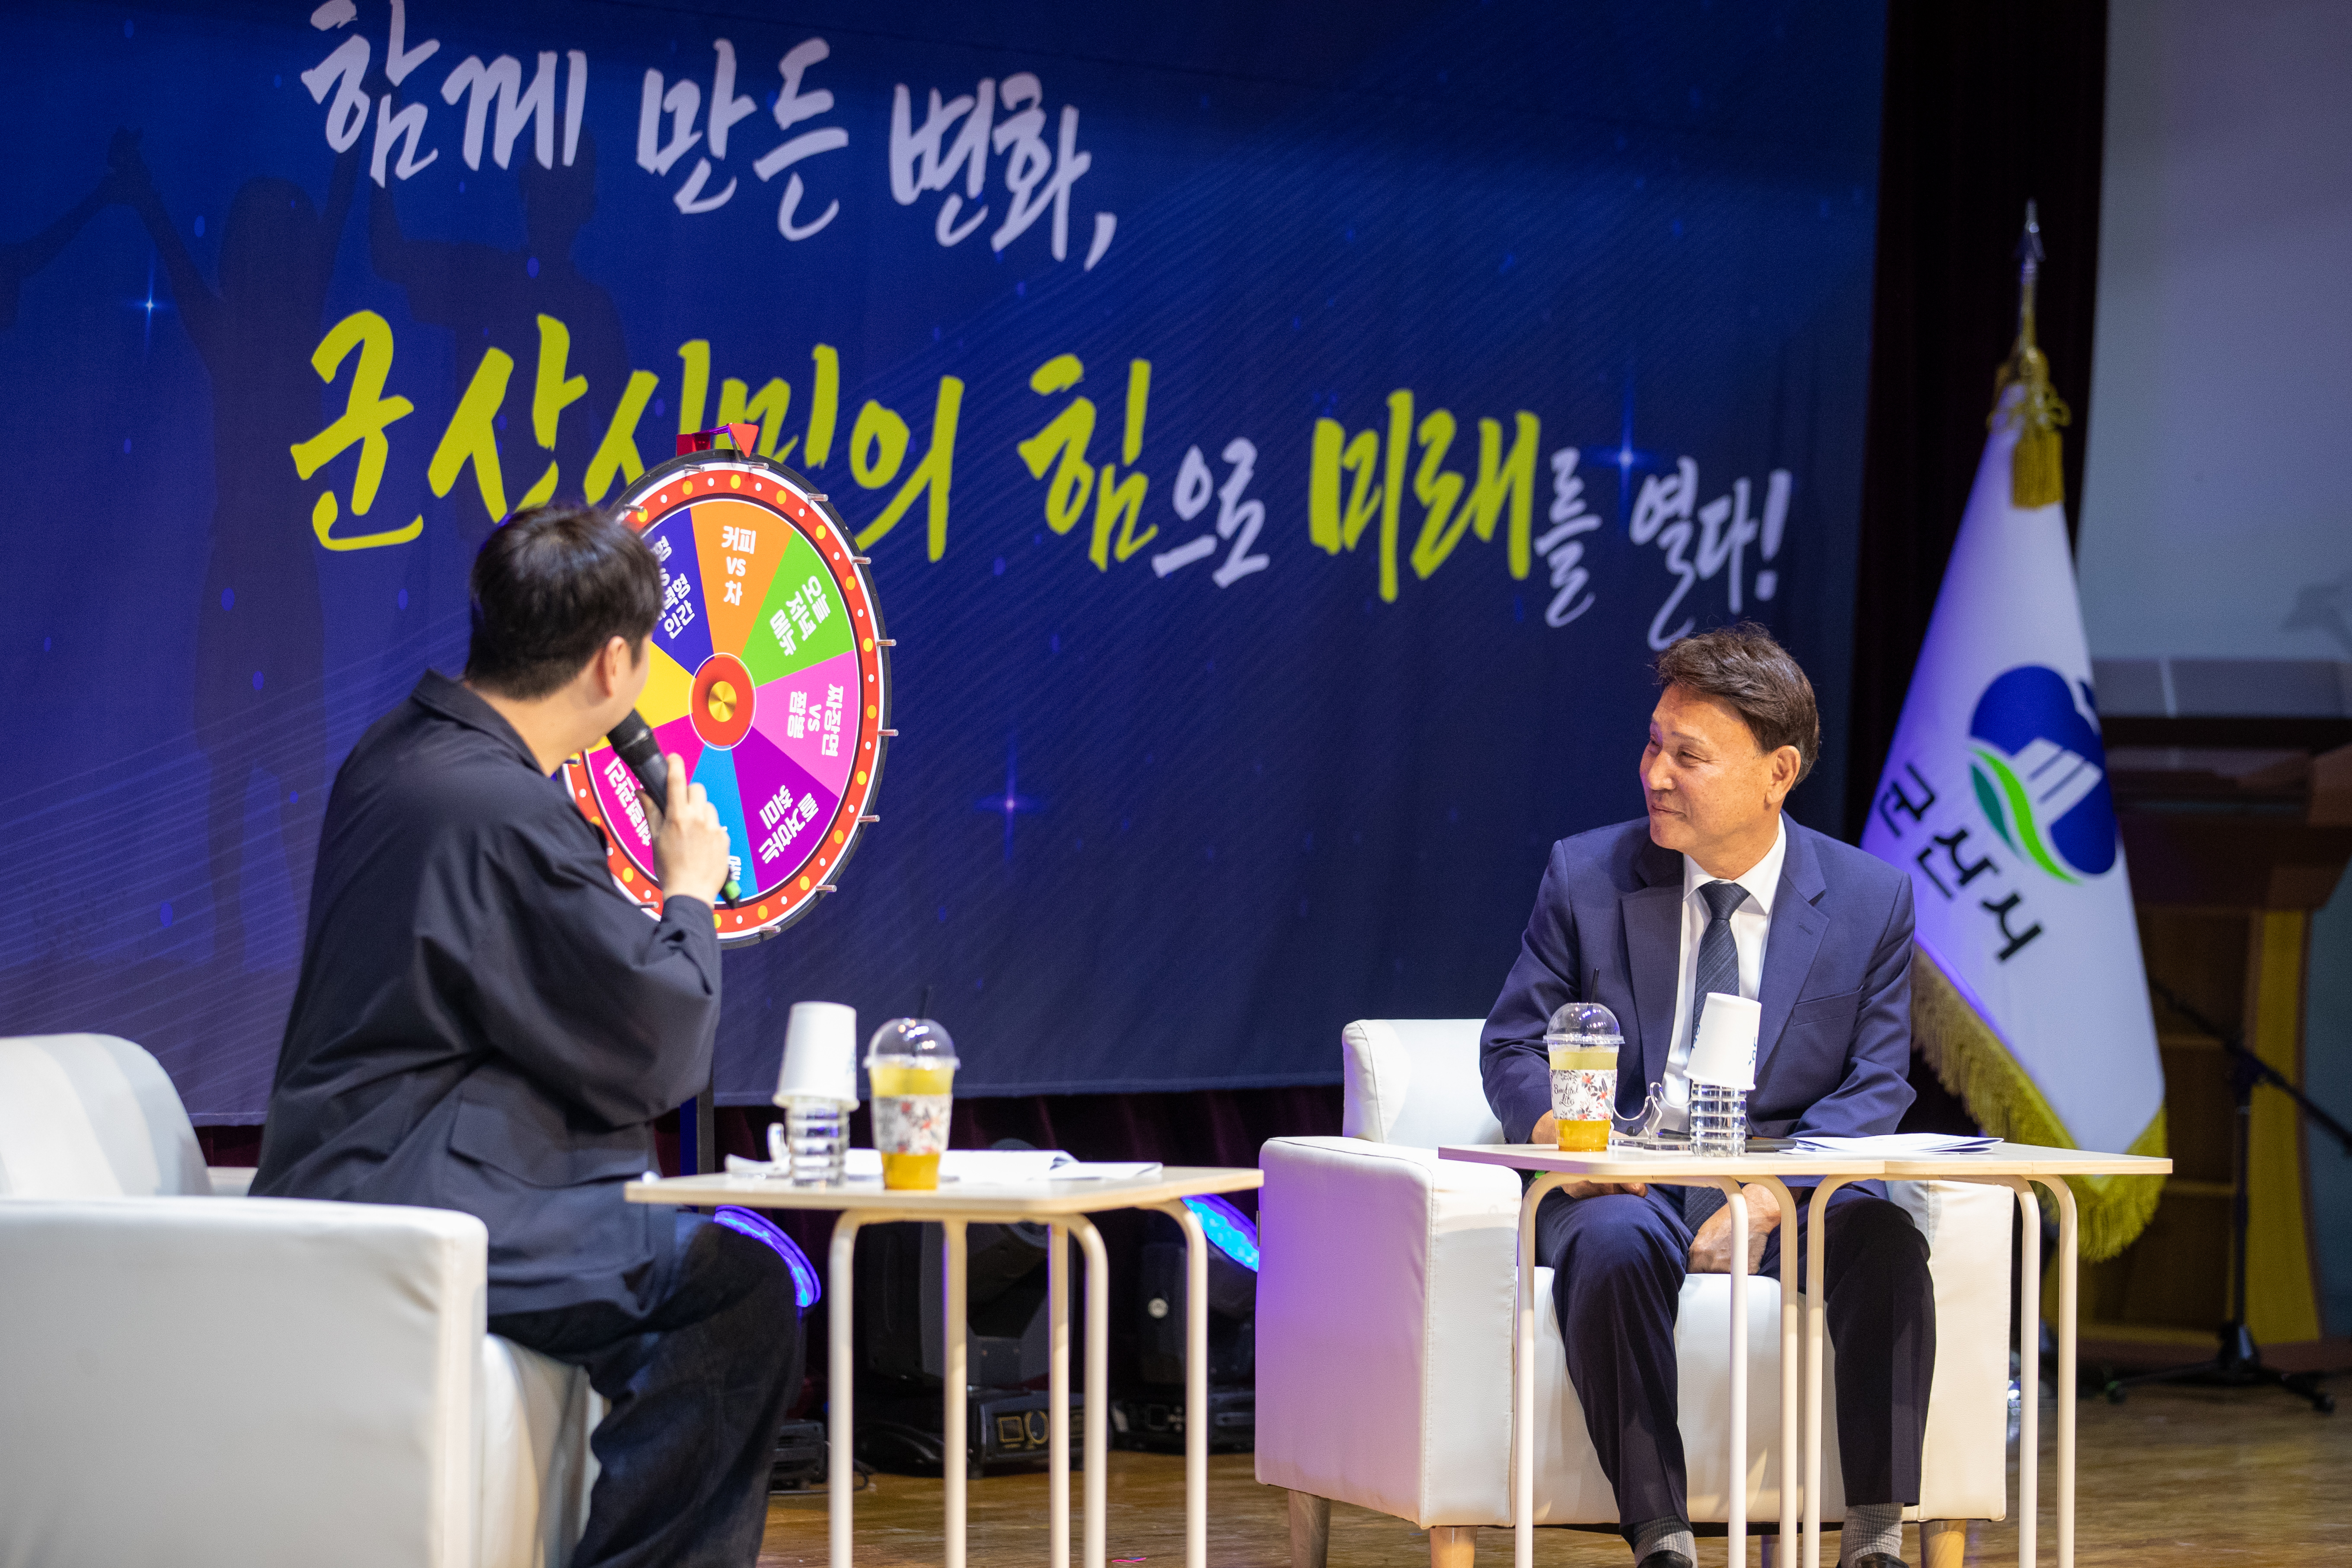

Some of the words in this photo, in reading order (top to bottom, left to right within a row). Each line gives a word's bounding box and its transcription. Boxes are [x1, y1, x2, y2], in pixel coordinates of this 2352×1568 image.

[300, 0, 588, 188] 함께
[636, 38, 849, 242] 만든
[888, 73, 1117, 272] 변화,
[1018, 354, 1270, 589] 힘으로
[1309, 390, 1602, 628] 미래를
[1629, 455, 1792, 651] 열다!
[721, 525, 756, 554] 커피
[726, 556, 746, 577] VS
[659, 573, 691, 620] 녁형
[723, 580, 743, 606] 차
[785, 591, 817, 641] 저녁
[802, 575, 830, 623] 오늘
[664, 600, 695, 639] 인간
[770, 609, 797, 656] 메뉴
[787, 691, 807, 739] 짬뽕
[807, 704, 822, 732] VS
[821, 683, 844, 757] 짜장면
[759, 785, 793, 830] 취미
[759, 793, 819, 864] 즐겨하는
[1878, 762, 2042, 963] 군산시
